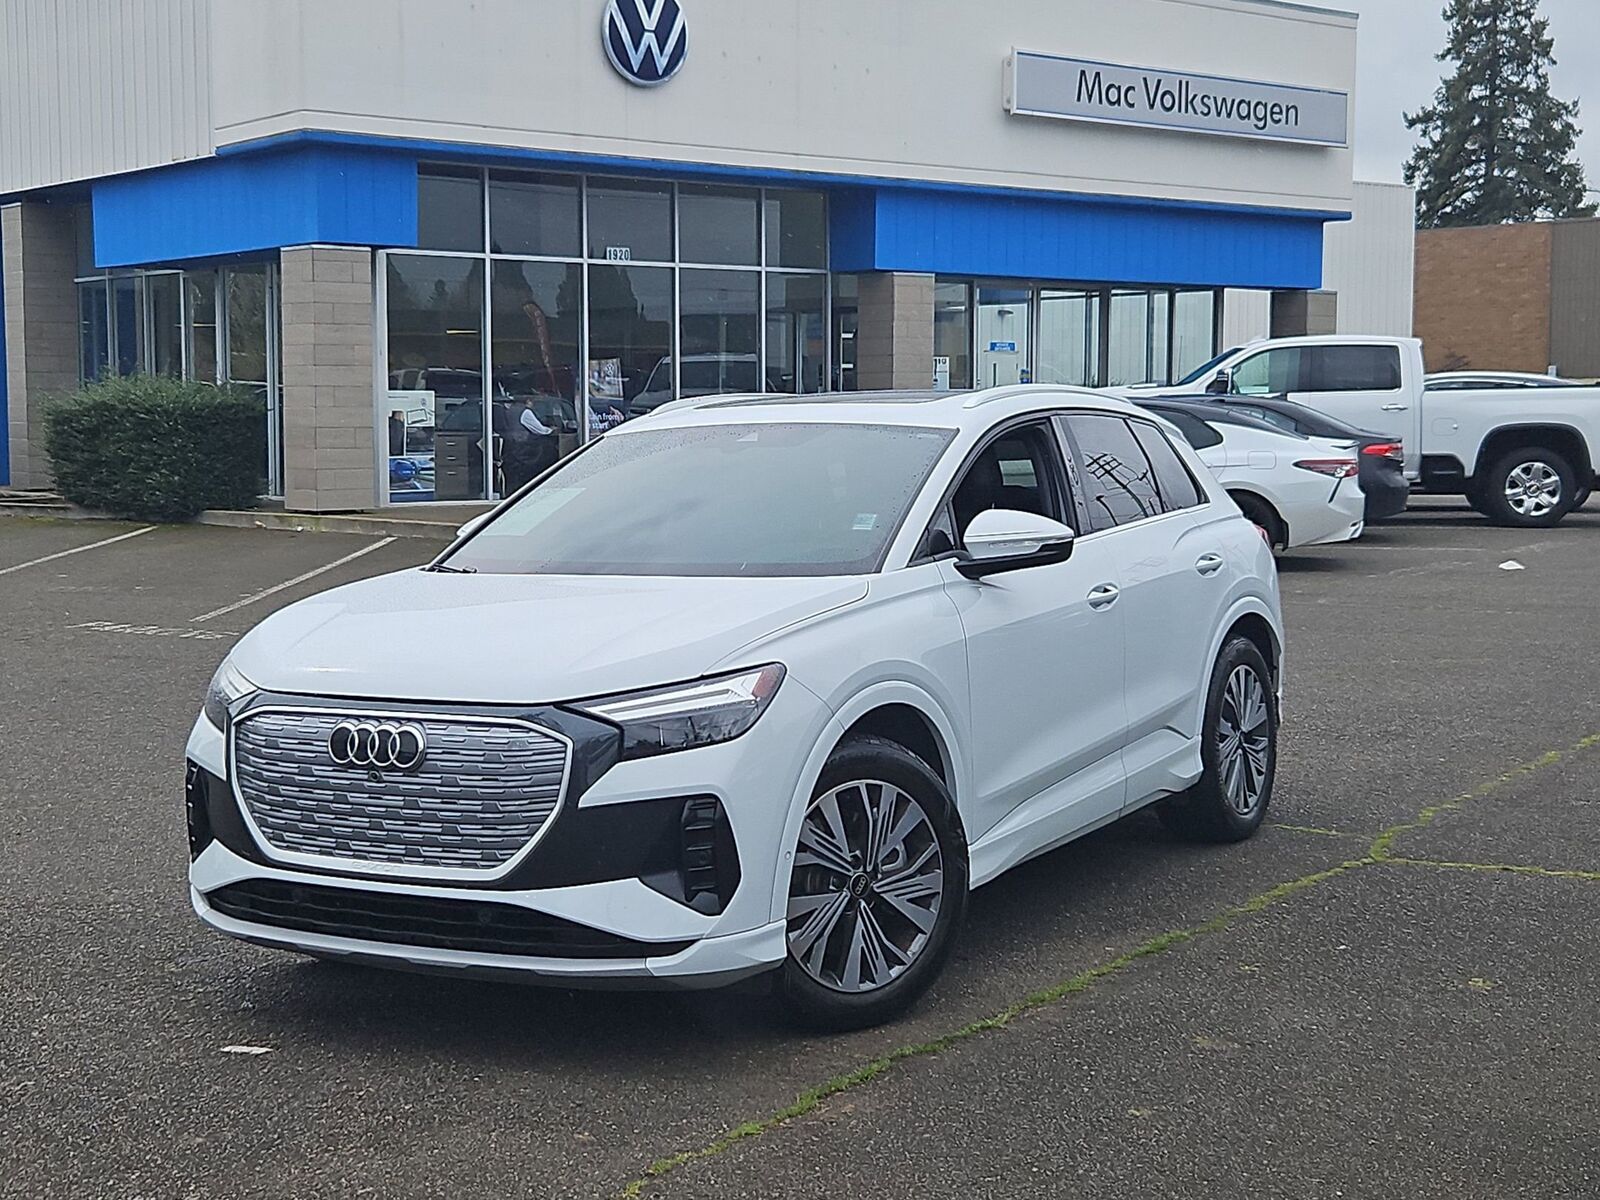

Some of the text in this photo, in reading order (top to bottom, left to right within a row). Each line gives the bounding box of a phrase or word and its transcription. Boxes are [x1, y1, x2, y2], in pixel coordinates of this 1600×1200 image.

[1076, 69, 1299, 130] Mac Volkswagen
[608, 248, 629, 260] 1920
